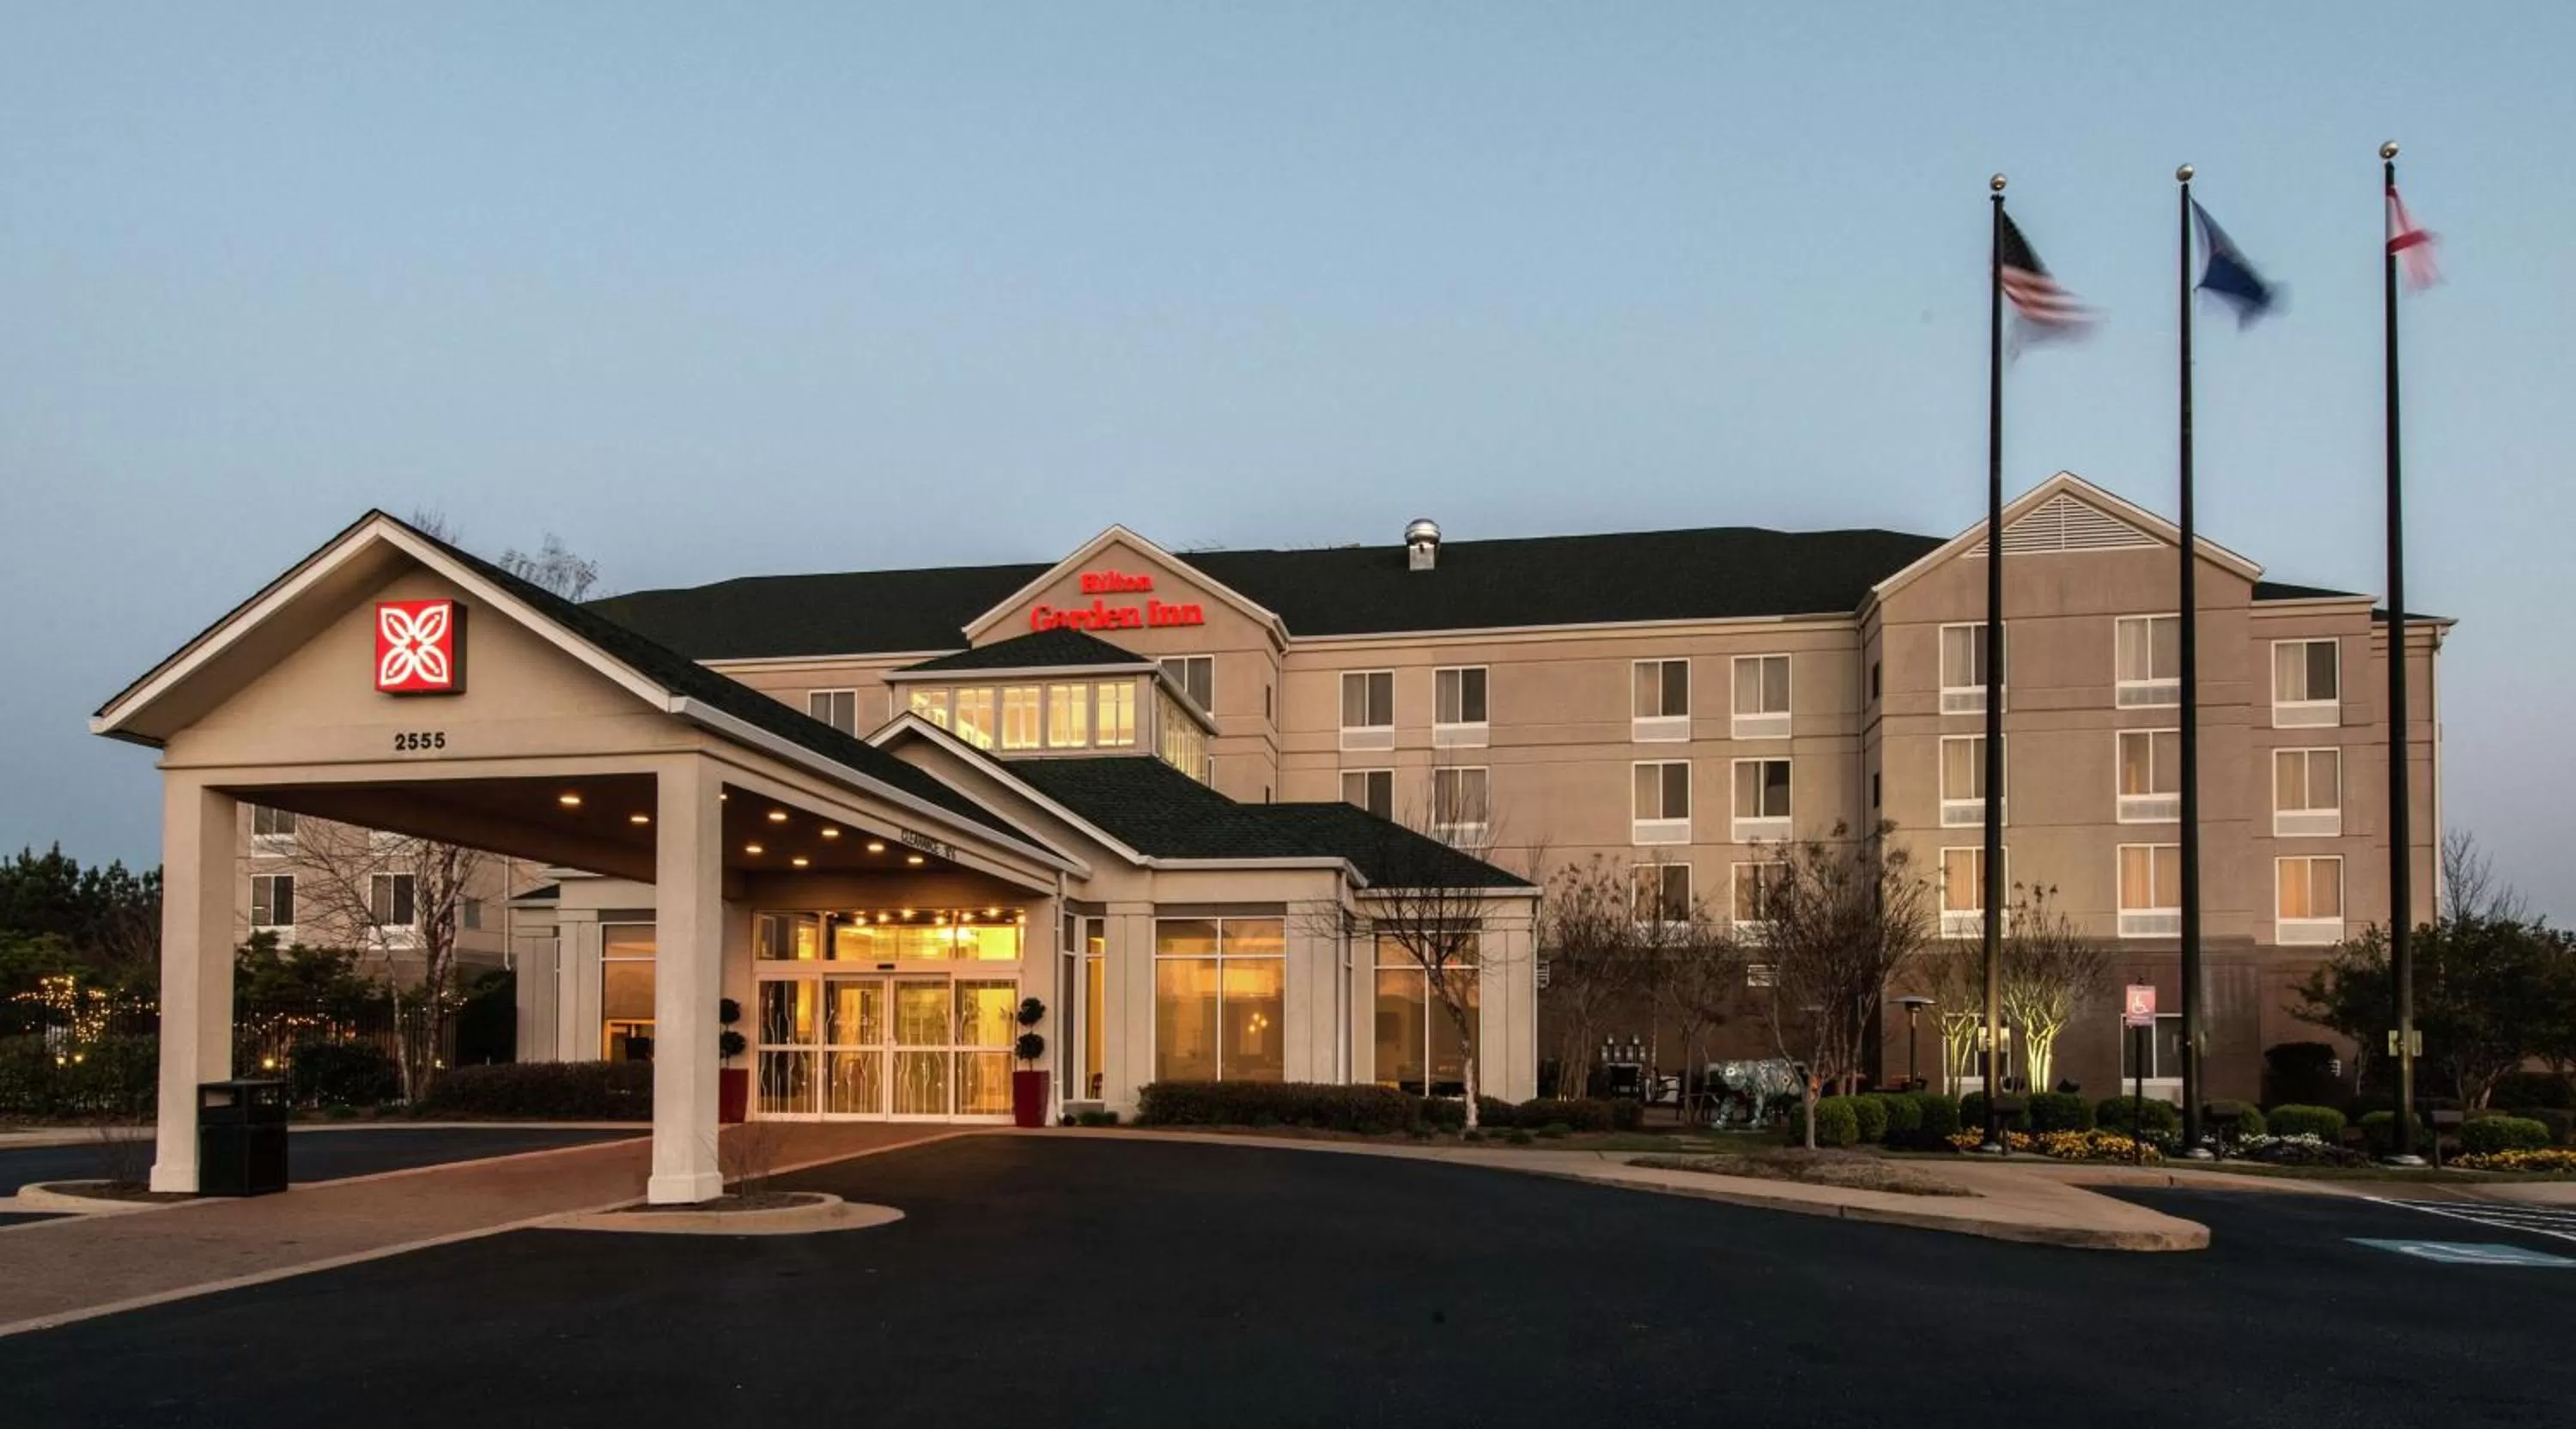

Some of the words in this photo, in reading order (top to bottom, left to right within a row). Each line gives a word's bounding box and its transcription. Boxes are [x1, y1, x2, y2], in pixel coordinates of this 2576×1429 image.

[1080, 570, 1153, 593] Hilton
[1030, 598, 1143, 631] Garden
[1146, 599, 1205, 627] Inn
[394, 732, 446, 751] 2555
